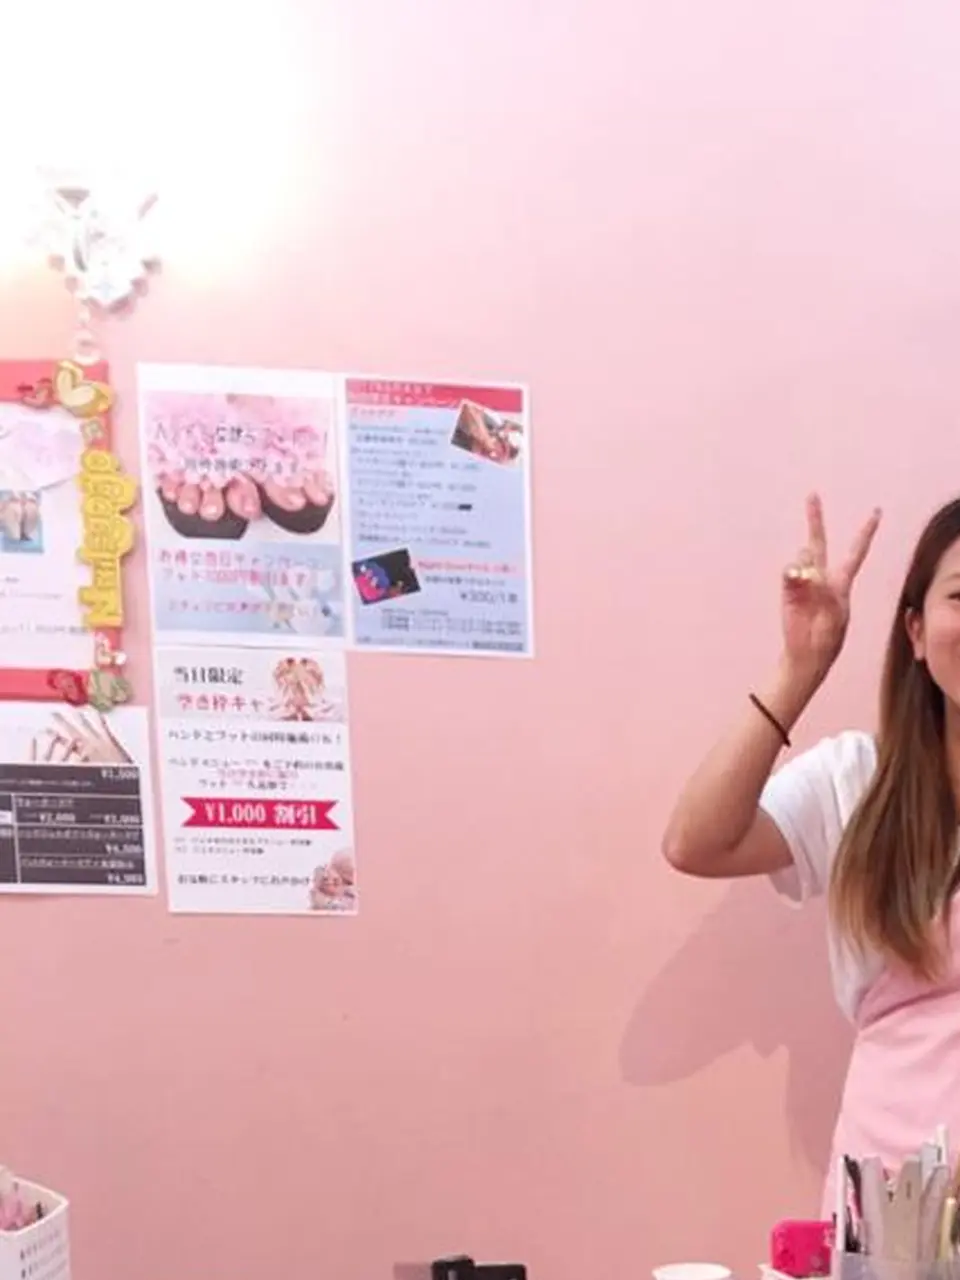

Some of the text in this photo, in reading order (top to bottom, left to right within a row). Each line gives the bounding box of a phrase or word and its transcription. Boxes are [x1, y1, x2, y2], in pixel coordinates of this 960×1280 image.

[173, 666, 244, 685] 当日限定
[273, 804, 318, 826] 割引
